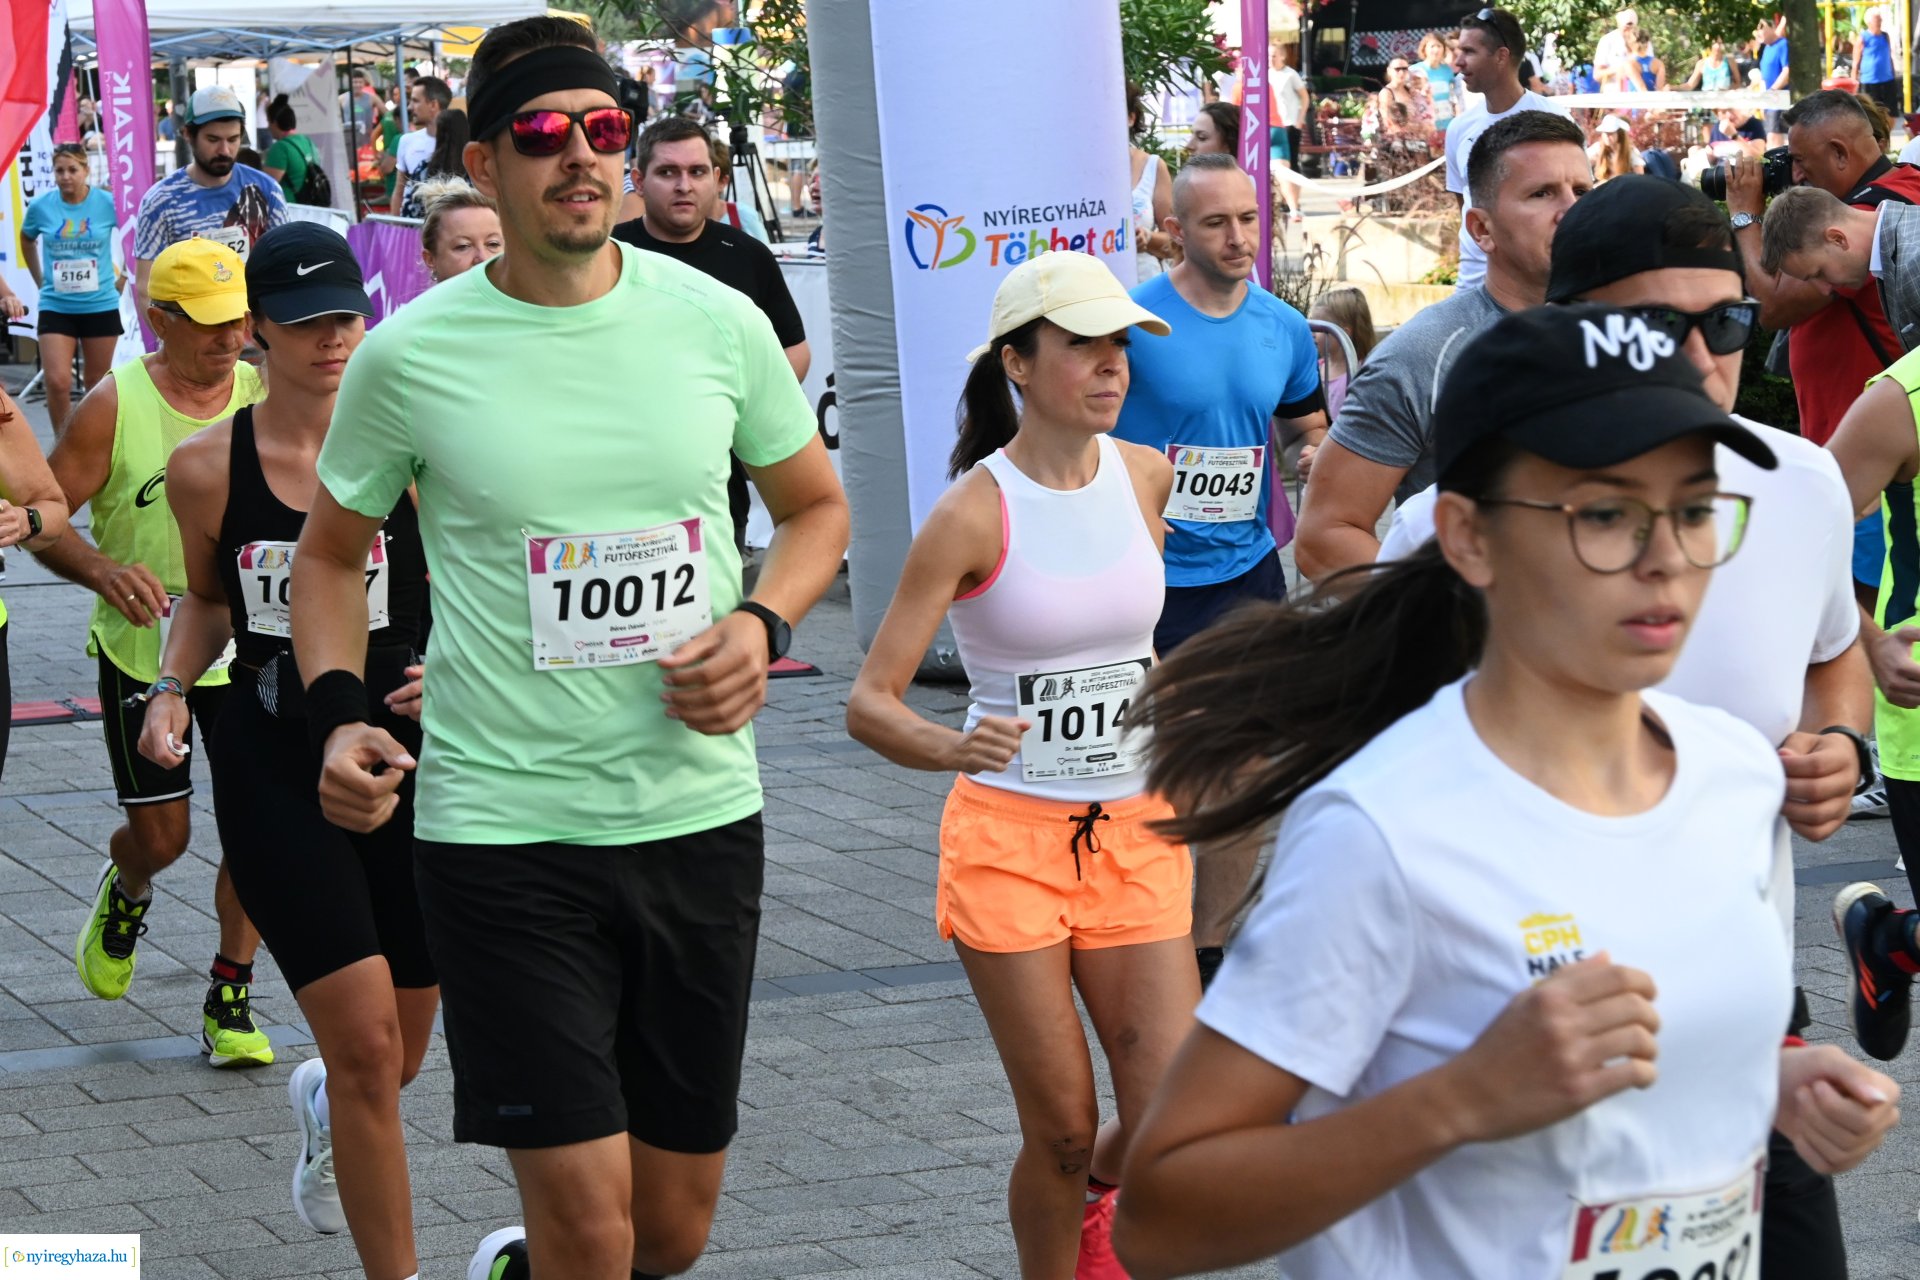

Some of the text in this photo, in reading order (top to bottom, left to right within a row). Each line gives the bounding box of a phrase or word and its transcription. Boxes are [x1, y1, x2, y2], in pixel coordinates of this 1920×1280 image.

[983, 198, 1107, 227] NYÍREGYHÁZA
[221, 240, 246, 254] 52
[984, 227, 1097, 267] Többet
[61, 269, 91, 282] 5164
[1176, 471, 1255, 497] 10043
[604, 542, 679, 563] FUTÓFESZTIVÁL
[552, 563, 695, 622] 10012
[1080, 677, 1138, 693] FUTÓFESZTIVÁL
[1524, 924, 1582, 955] CPH
